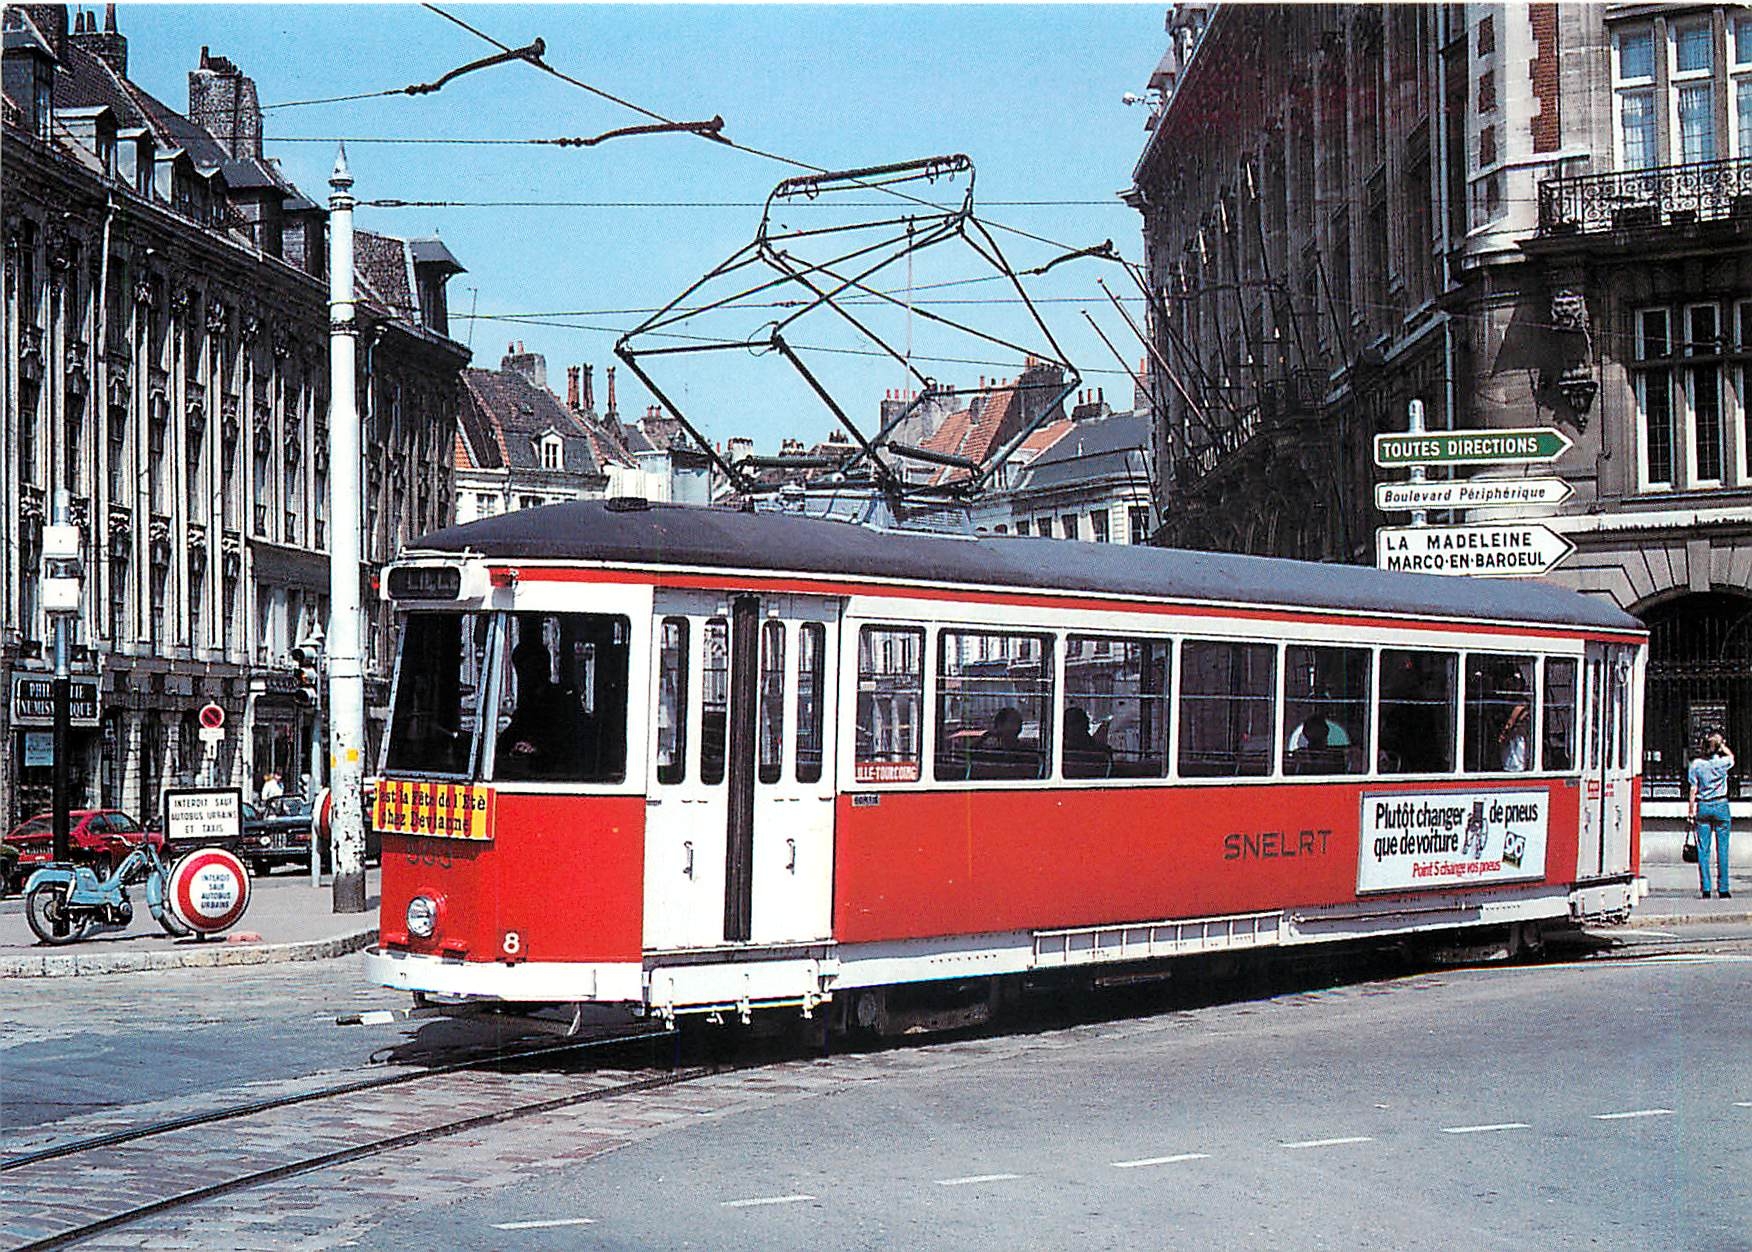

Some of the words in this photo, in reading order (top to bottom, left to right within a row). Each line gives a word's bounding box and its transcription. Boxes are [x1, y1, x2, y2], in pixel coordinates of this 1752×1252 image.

[1383, 441, 1440, 458] TOUTES
[1448, 437, 1538, 456] DIRECTIONS
[1384, 488, 1451, 503] Boulevard
[1460, 485, 1545, 501] Périphérique
[1387, 536, 1409, 550] LA
[1427, 531, 1533, 549] MADELEINE
[174, 799, 208, 808] INTERDIT
[171, 811, 203, 821] AUTOBUS
[207, 810, 236, 820] URBAINS
[1376, 801, 1414, 829] Plutôt
[1417, 801, 1465, 830] changer
[1489, 800, 1503, 824] de
[1505, 803, 1538, 828] pneus
[185, 825, 193, 834] ET
[202, 824, 223, 833] TAXIS
[1224, 830, 1332, 860] SNELRT
[1374, 835, 1398, 862] que
[1400, 829, 1416, 854] de
[1417, 828, 1459, 852] voiture
[1412, 861, 1433, 878] Point
[1440, 860, 1466, 877] change
[1467, 861, 1478, 874] vos
[1479, 860, 1501, 876] pneus
[201, 892, 231, 900] AUTOBUS
[503, 932, 520, 954] 8
